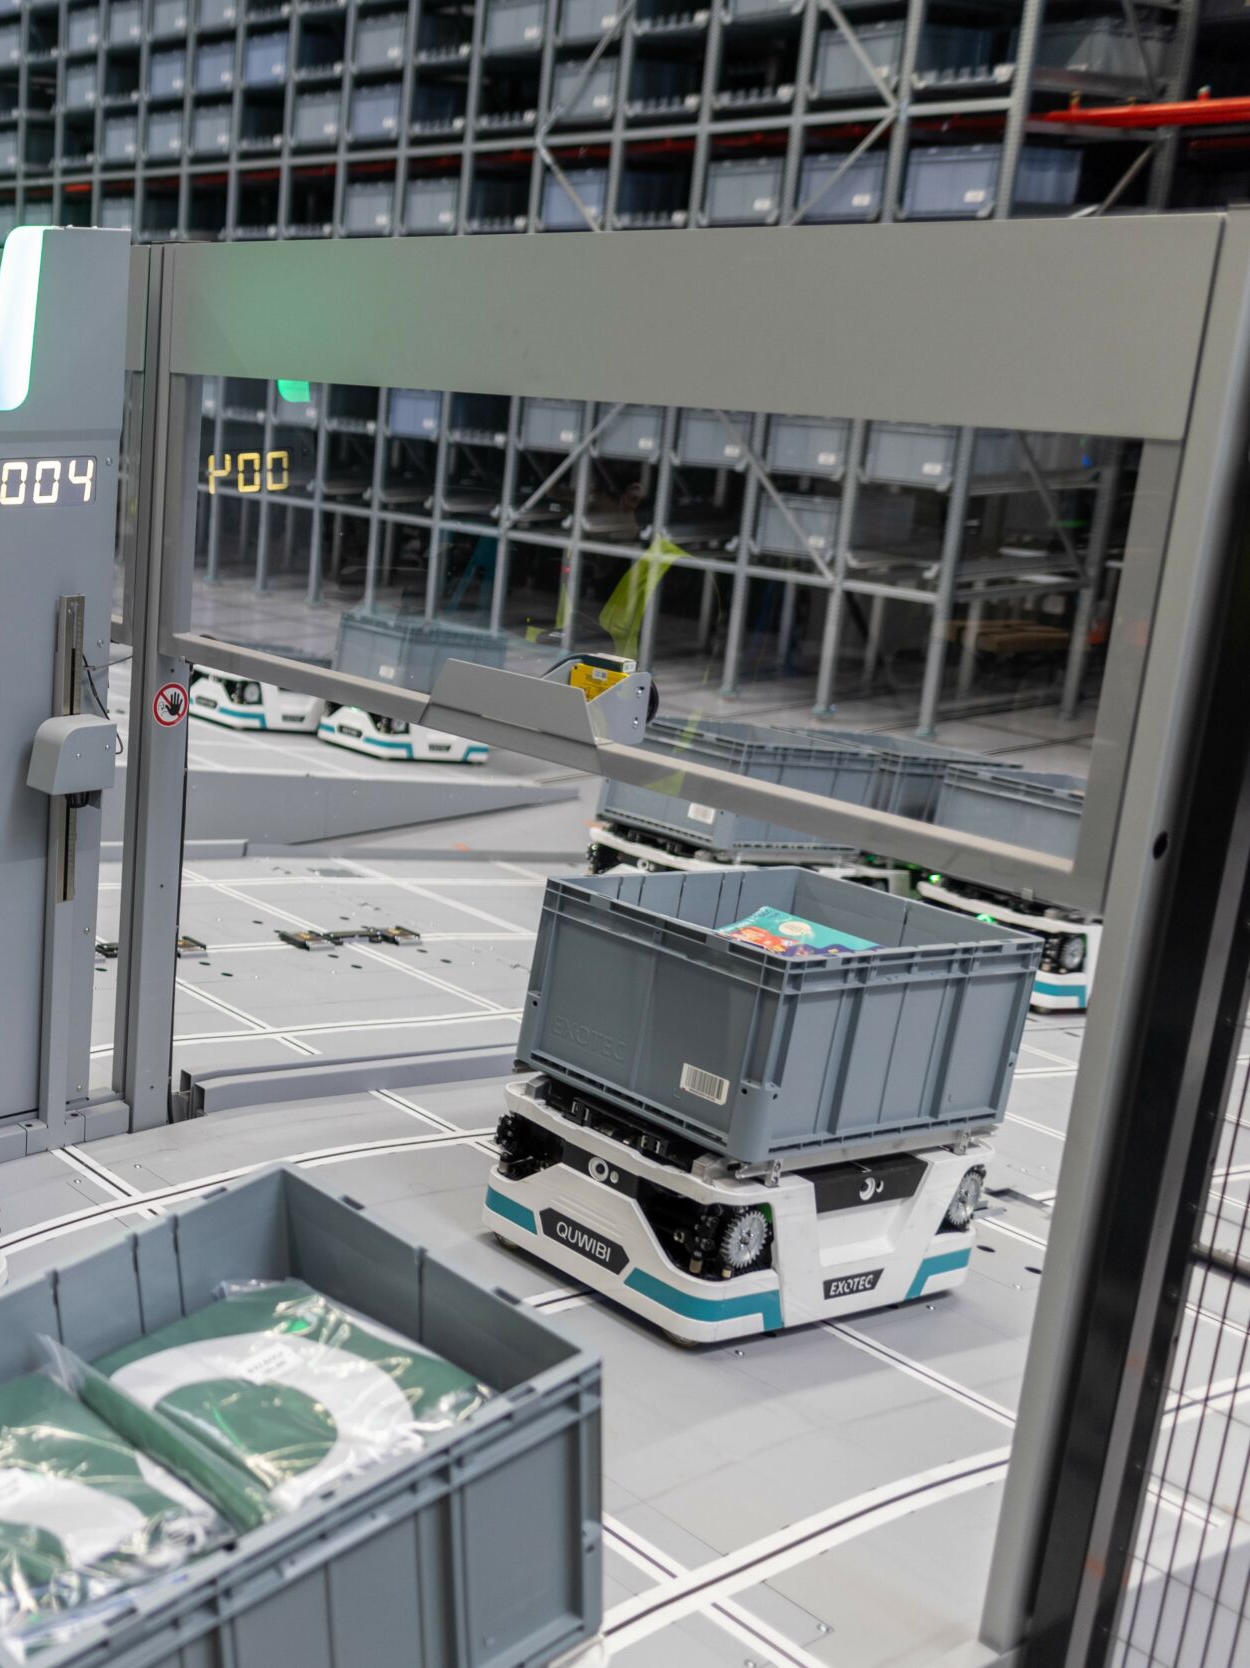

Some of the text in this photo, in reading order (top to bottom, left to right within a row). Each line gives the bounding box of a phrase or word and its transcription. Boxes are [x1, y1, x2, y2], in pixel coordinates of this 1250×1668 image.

[0, 459, 94, 505] 004
[550, 1015, 629, 1061] EXOTEC
[556, 1221, 611, 1262] QUWIBI
[830, 1274, 874, 1296] EXOTEC
